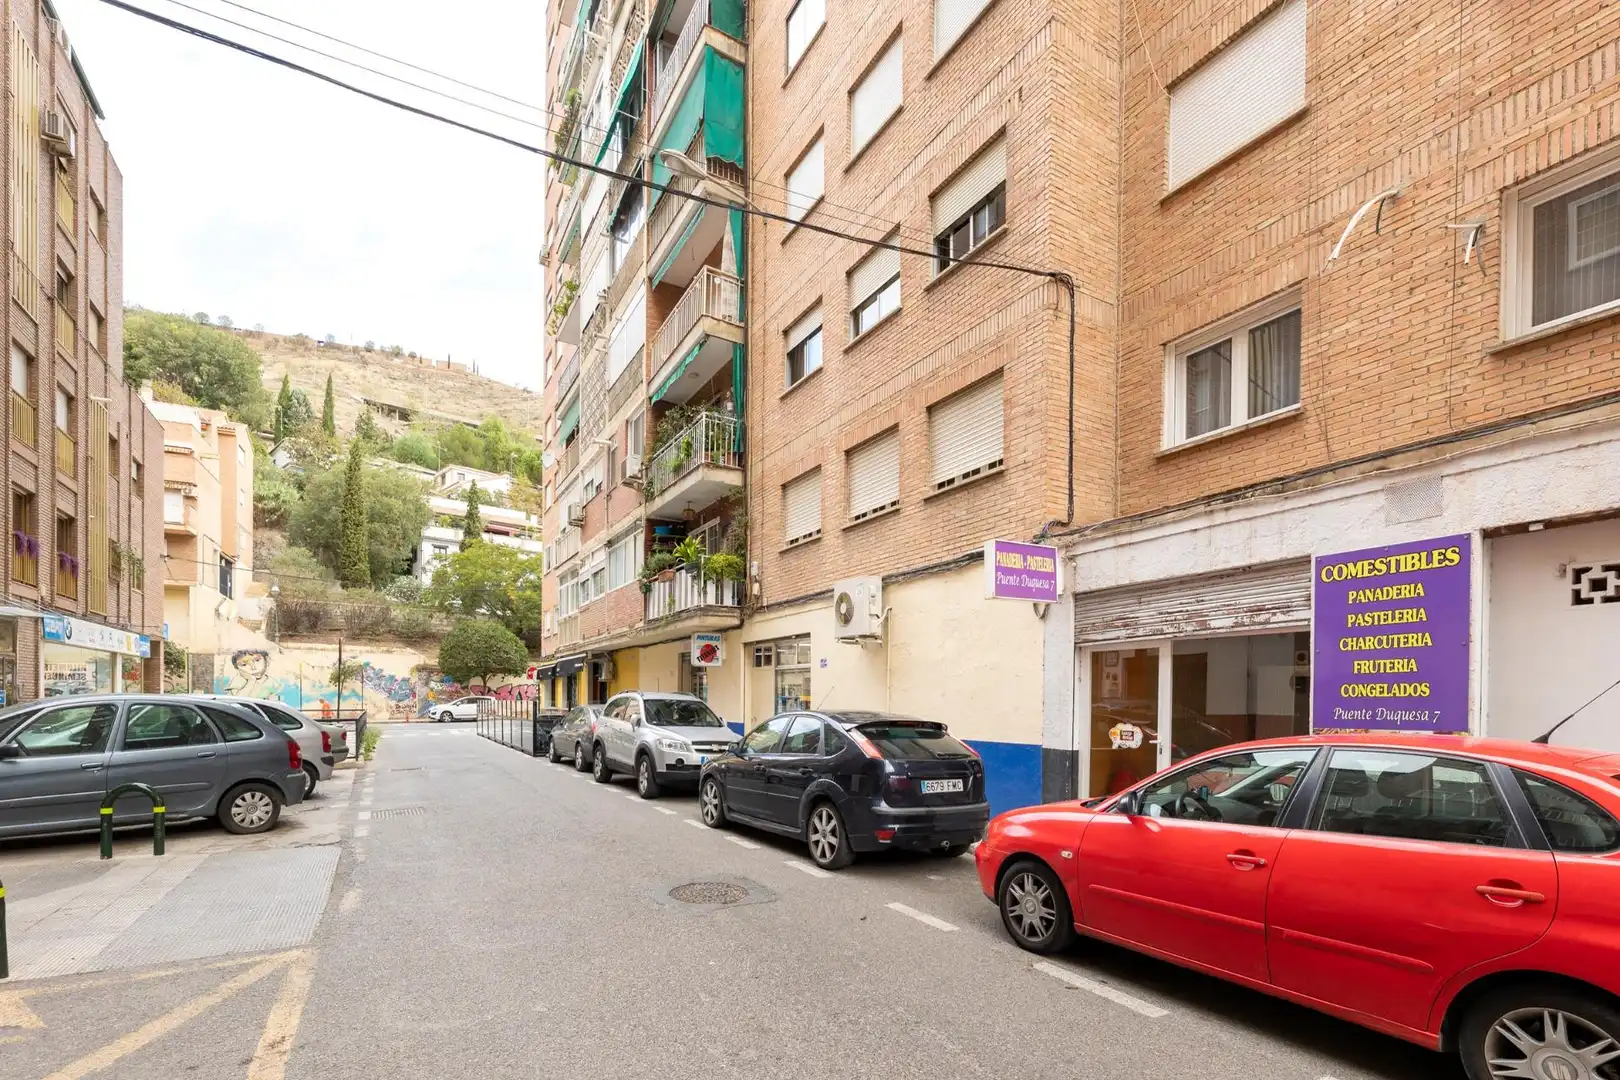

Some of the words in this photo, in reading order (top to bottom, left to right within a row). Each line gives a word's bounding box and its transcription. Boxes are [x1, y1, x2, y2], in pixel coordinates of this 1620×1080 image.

[996, 551, 1024, 570] PANADERIA
[1026, 554, 1055, 573] PASTELERIA
[1320, 546, 1461, 583] COMESTIBLES
[996, 571, 1020, 586] Puente
[1021, 574, 1049, 592] Duquesa
[1050, 580, 1055, 592] 7
[1348, 582, 1425, 604] PANADERIA
[1347, 607, 1427, 627] PASTELERIA
[1339, 632, 1433, 651] CHARCUTERIA
[1353, 658, 1417, 674] FRUTERIA
[1340, 683, 1430, 698] CONGELADOS
[1333, 707, 1372, 721] Puente
[1376, 707, 1429, 725] Duquesa
[1433, 711, 1441, 723] 7
[926, 781, 944, 792] 6679
[946, 780, 962, 791] FMC
